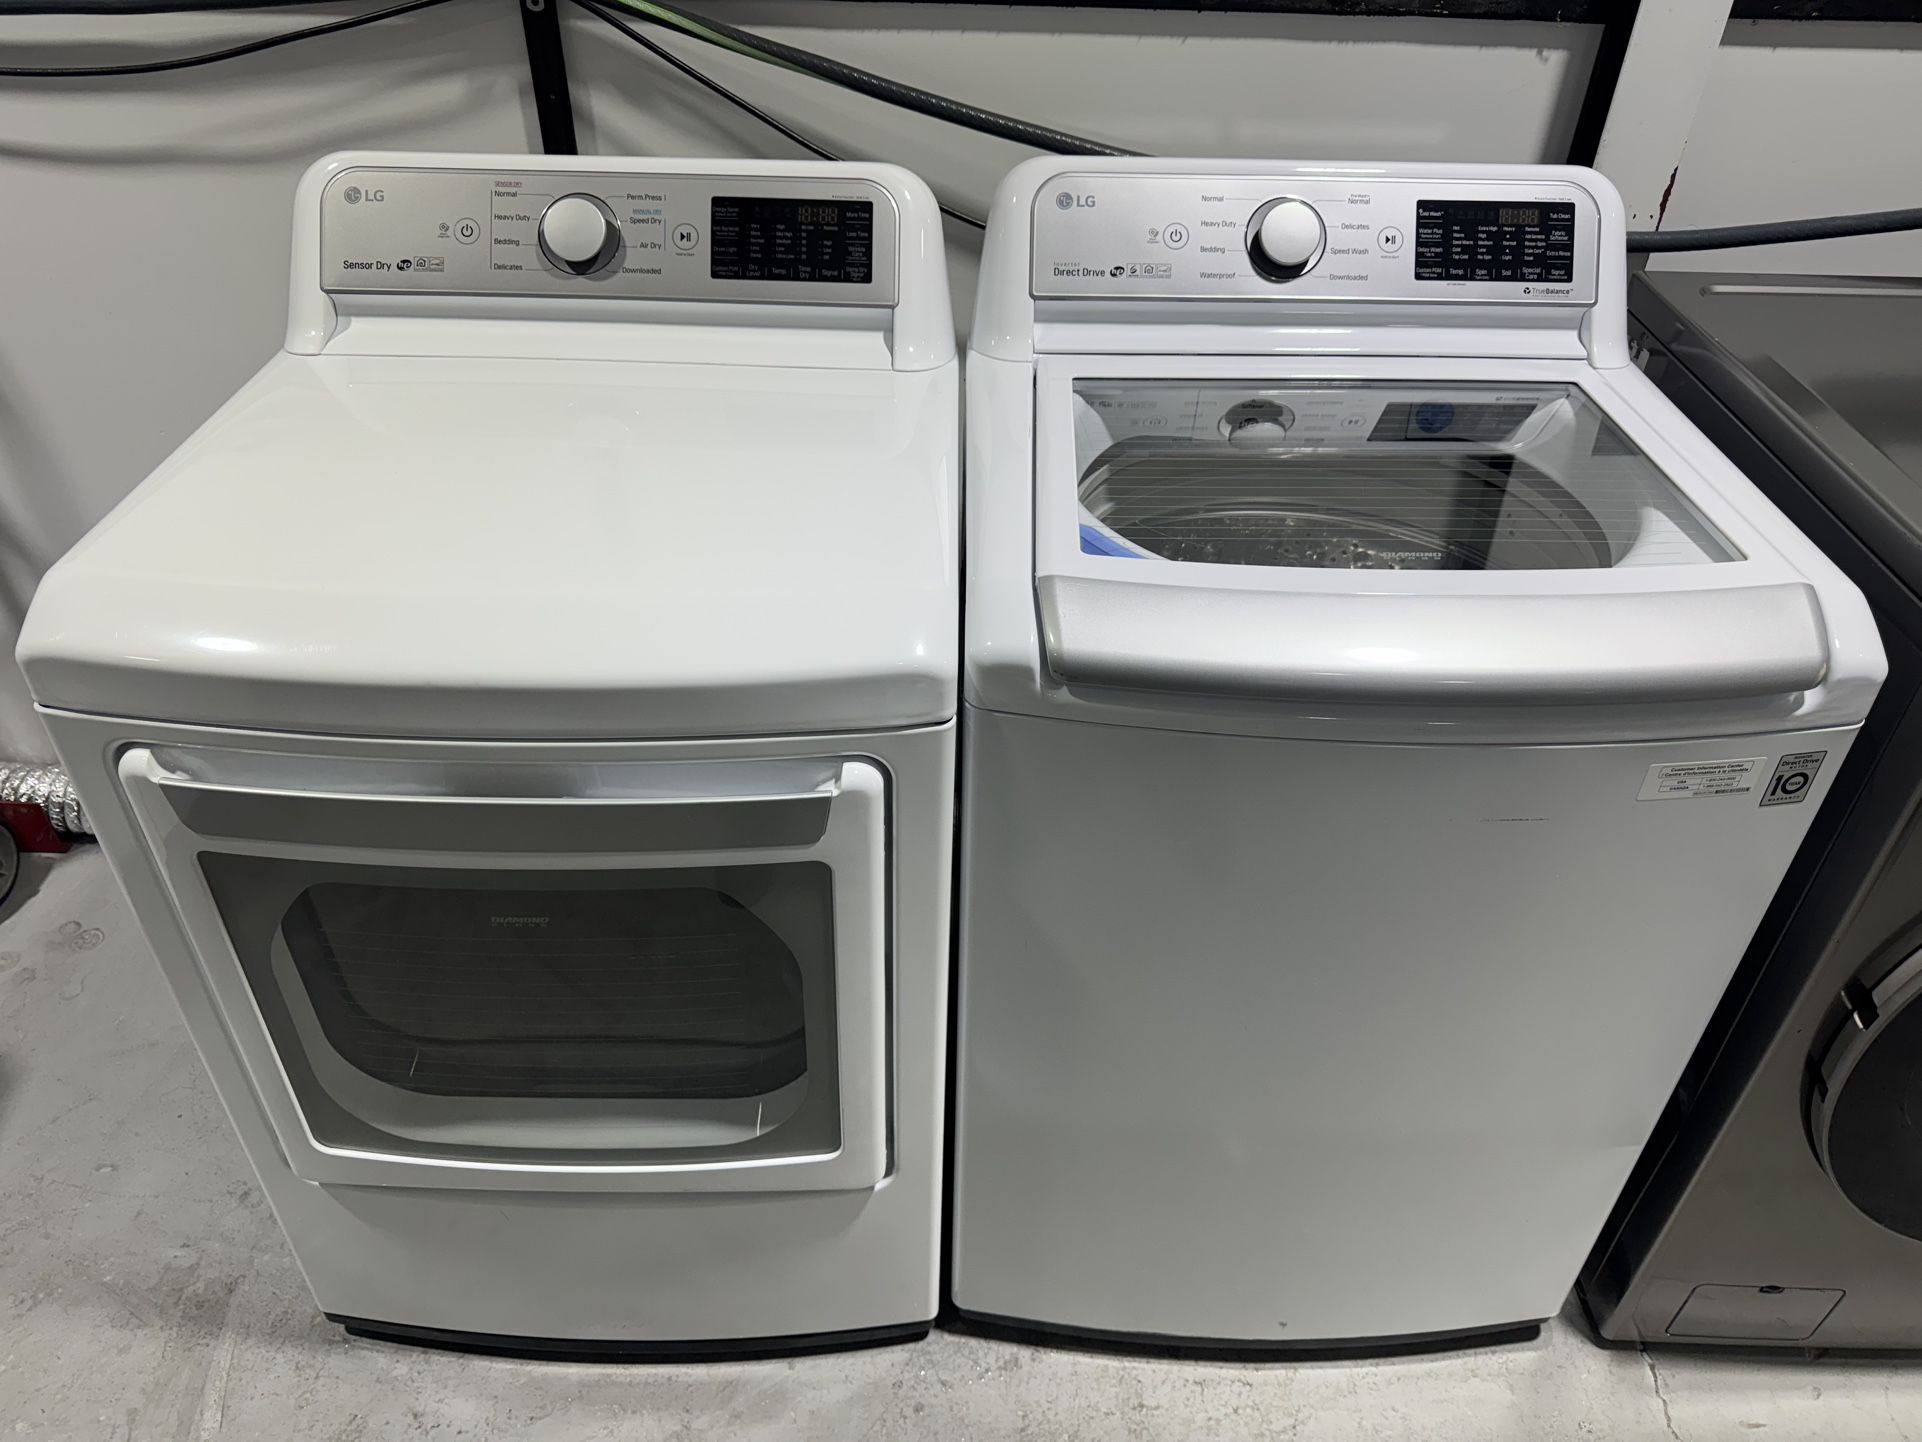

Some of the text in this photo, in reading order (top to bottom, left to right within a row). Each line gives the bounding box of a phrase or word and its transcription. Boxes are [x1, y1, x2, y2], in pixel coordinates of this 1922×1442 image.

[364, 189, 385, 202] LG
[626, 193, 662, 202] Perm Press
[1076, 194, 1096, 208] LG
[1347, 197, 1371, 205] Normal
[494, 213, 531, 222] Heavy Duty
[629, 216, 662, 225] Speed Dry
[1200, 219, 1237, 229] Heavy Duty
[1340, 222, 1370, 230] Delicates
[494, 238, 520, 247] Bedding
[650, 242, 662, 251] Dry
[1200, 246, 1226, 254] Bedding
[1330, 247, 1350, 256] Speed
[343, 260, 392, 272] Sensor Dry
[493, 263, 523, 271] Delicates
[622, 266, 662, 275] Downloaded
[1521, 266, 1541, 274] Special
[1053, 267, 1106, 277] Direct Drive
[1199, 271, 1236, 280] Waterproof
[1329, 273, 1369, 281] Downloaded
[1781, 759, 1802, 767] Direct
[1770, 771, 1810, 797] 10
